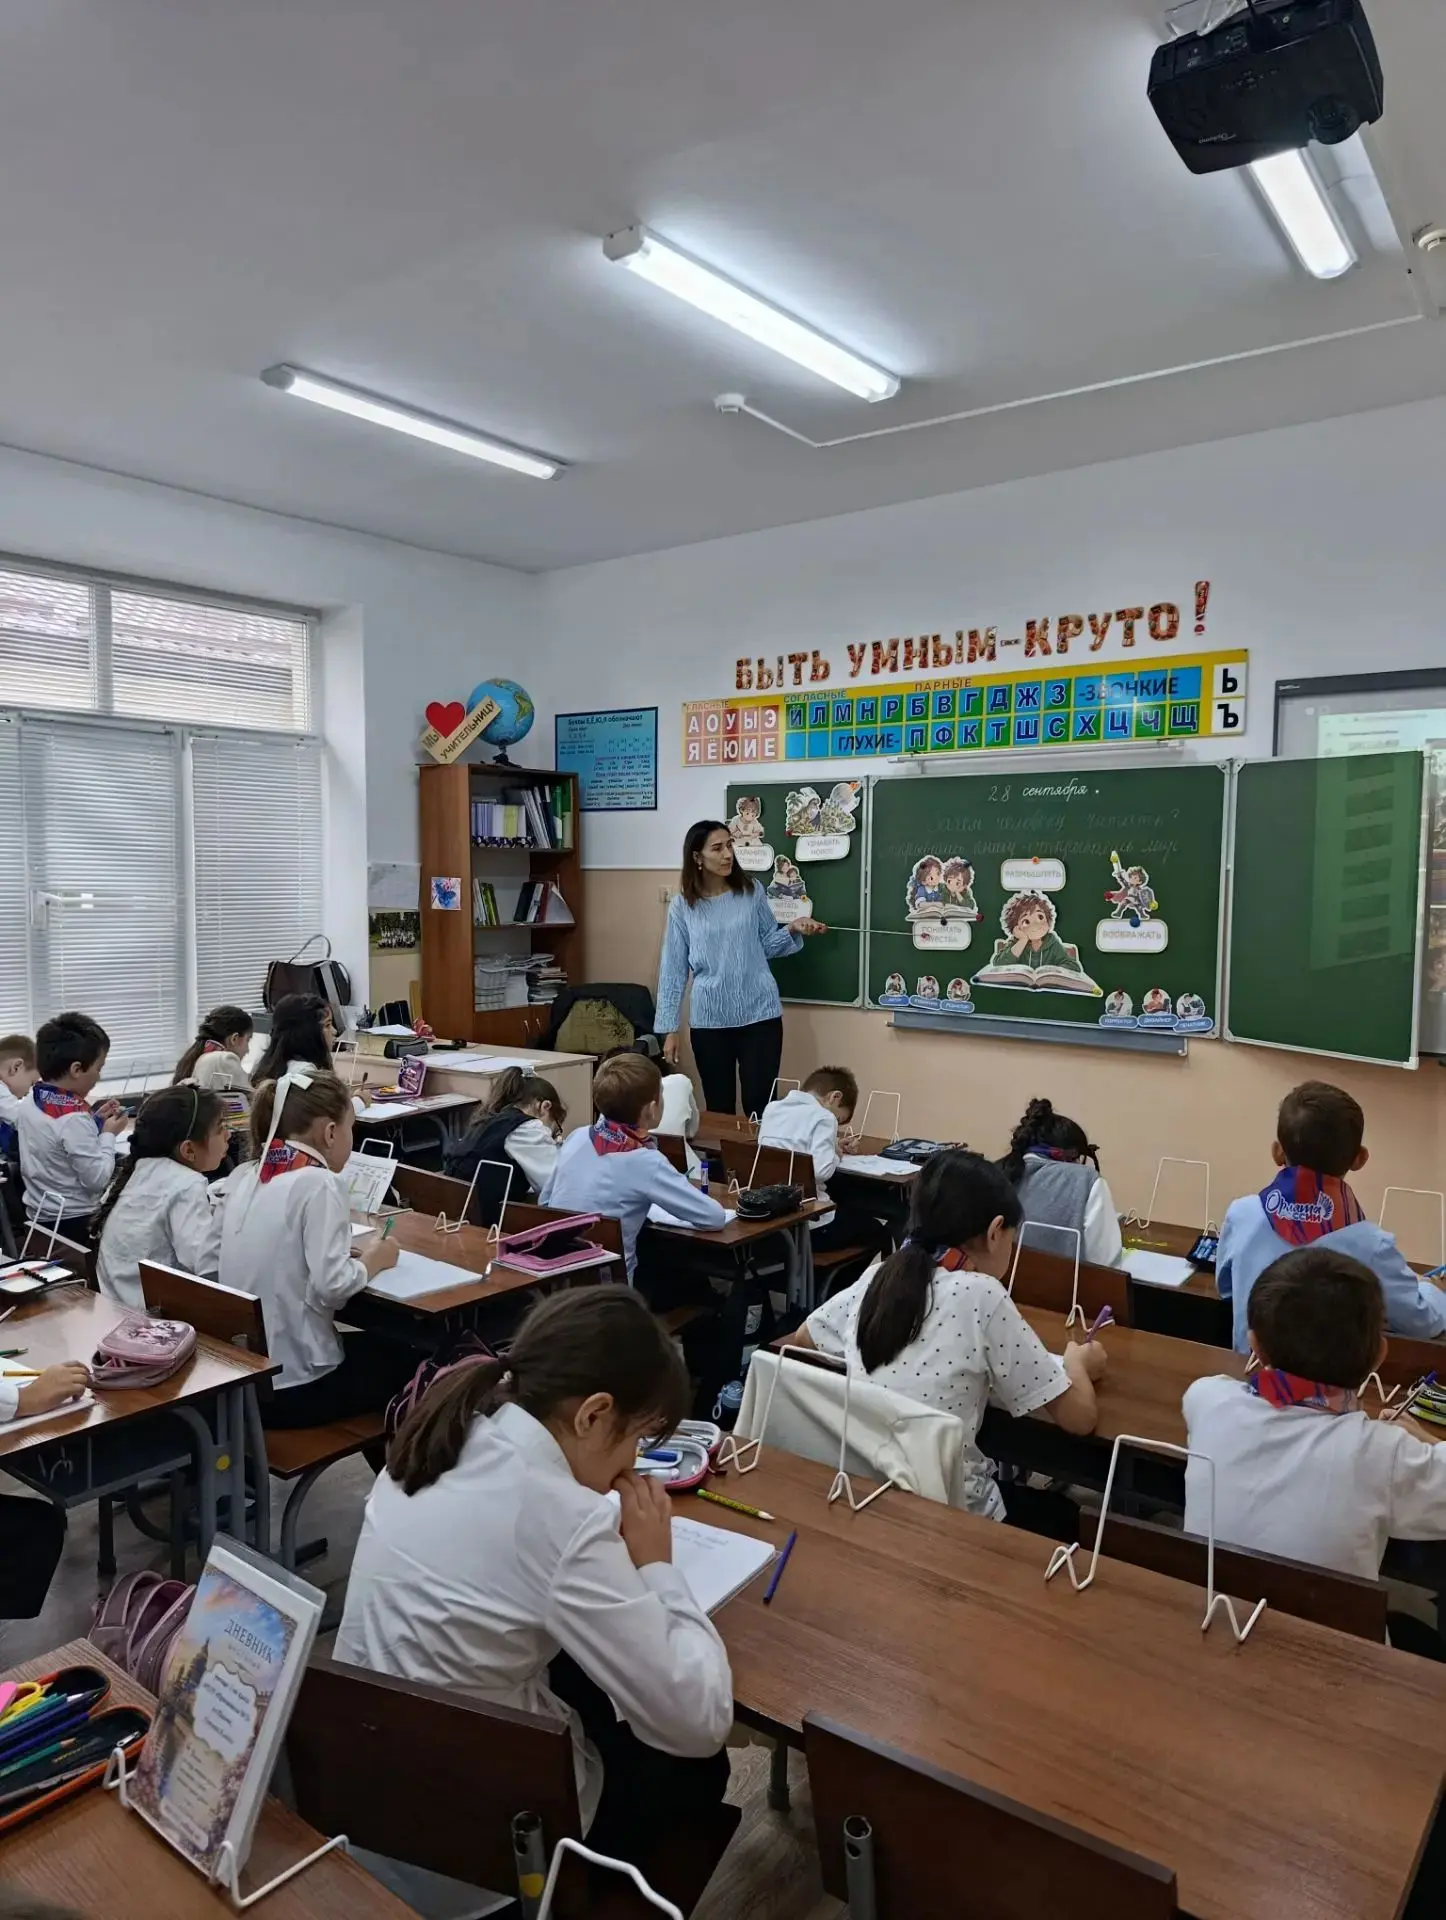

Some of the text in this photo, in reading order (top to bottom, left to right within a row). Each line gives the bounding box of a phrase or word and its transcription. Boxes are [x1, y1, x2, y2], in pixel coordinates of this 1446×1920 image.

[735, 650, 831, 691] БЫТЬ
[1222, 668, 1238, 694] Ь
[783, 690, 848, 703] СОГЛАСНЫЕ
[914, 678, 974, 692] ПАРНЫЕ
[686, 700, 730, 711] ГЛАСНЫЕ
[812, 706, 826, 724] Л
[835, 704, 851, 723] М
[861, 702, 875, 721] Н
[887, 699, 899, 718] Р
[911, 697, 925, 716] Б
[938, 695, 952, 715] В
[965, 693, 978, 712] Г
[990, 688, 1009, 712] Д
[1017, 686, 1040, 708] Ж
[1051, 683, 1066, 705] З
[688, 709, 777, 733] А О У Ы Э
[838, 705, 1198, 751] ГЛУХИЕ- П Ф К Т Ш С Х Ц Ч Щ
[1217, 704, 1240, 728] Ъ
[440, 700, 495, 759] УЧИТЕЛЬНИЦУ
[688, 738, 776, 761] Я Ё Ю И Е
[988, 785, 1012, 802] 28
[223, 1618, 276, 1664] ДНЕВНИК
